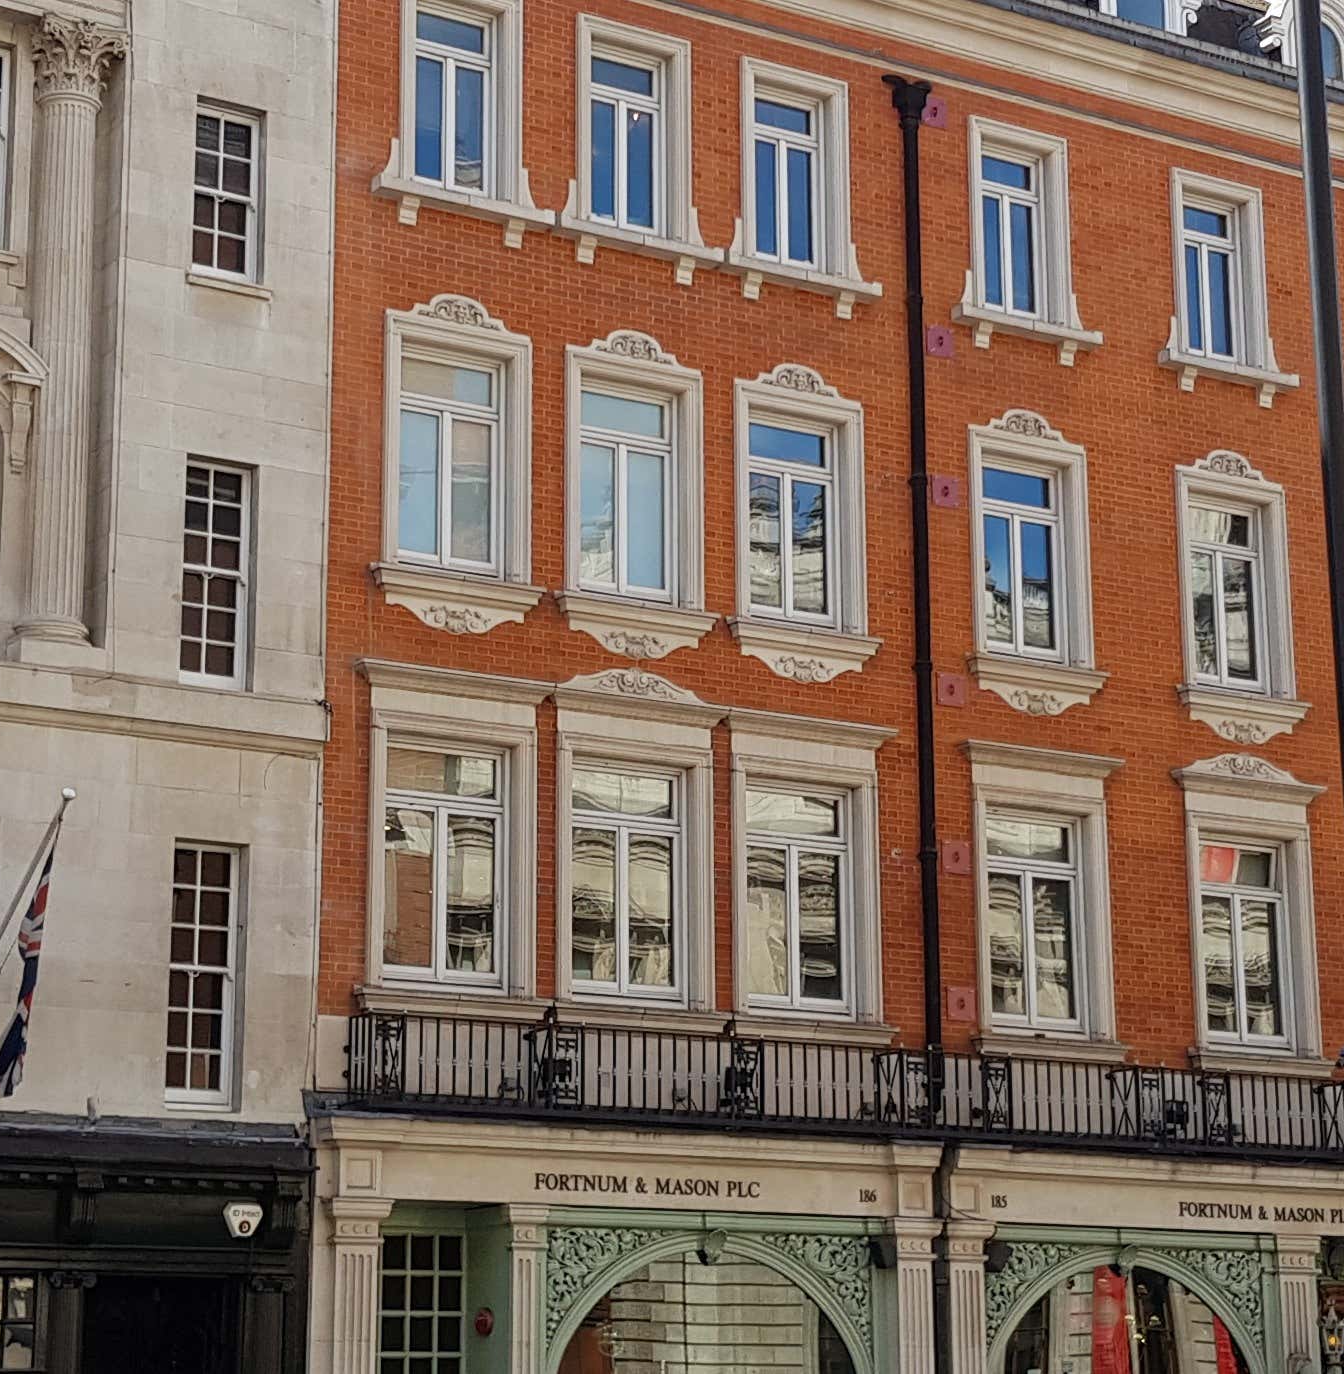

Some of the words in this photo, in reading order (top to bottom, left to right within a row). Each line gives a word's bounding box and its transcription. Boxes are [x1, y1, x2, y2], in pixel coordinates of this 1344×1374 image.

[534, 1172, 628, 1193] FORTNUM
[635, 1176, 648, 1194] &
[655, 1177, 719, 1197] MASON
[726, 1181, 761, 1198] PLC
[859, 1188, 877, 1203] 186
[991, 1194, 1007, 1208] 185
[1178, 1201, 1253, 1220] FORTNUM
[1258, 1206, 1269, 1220] &
[1273, 1206, 1325, 1223] MASON
